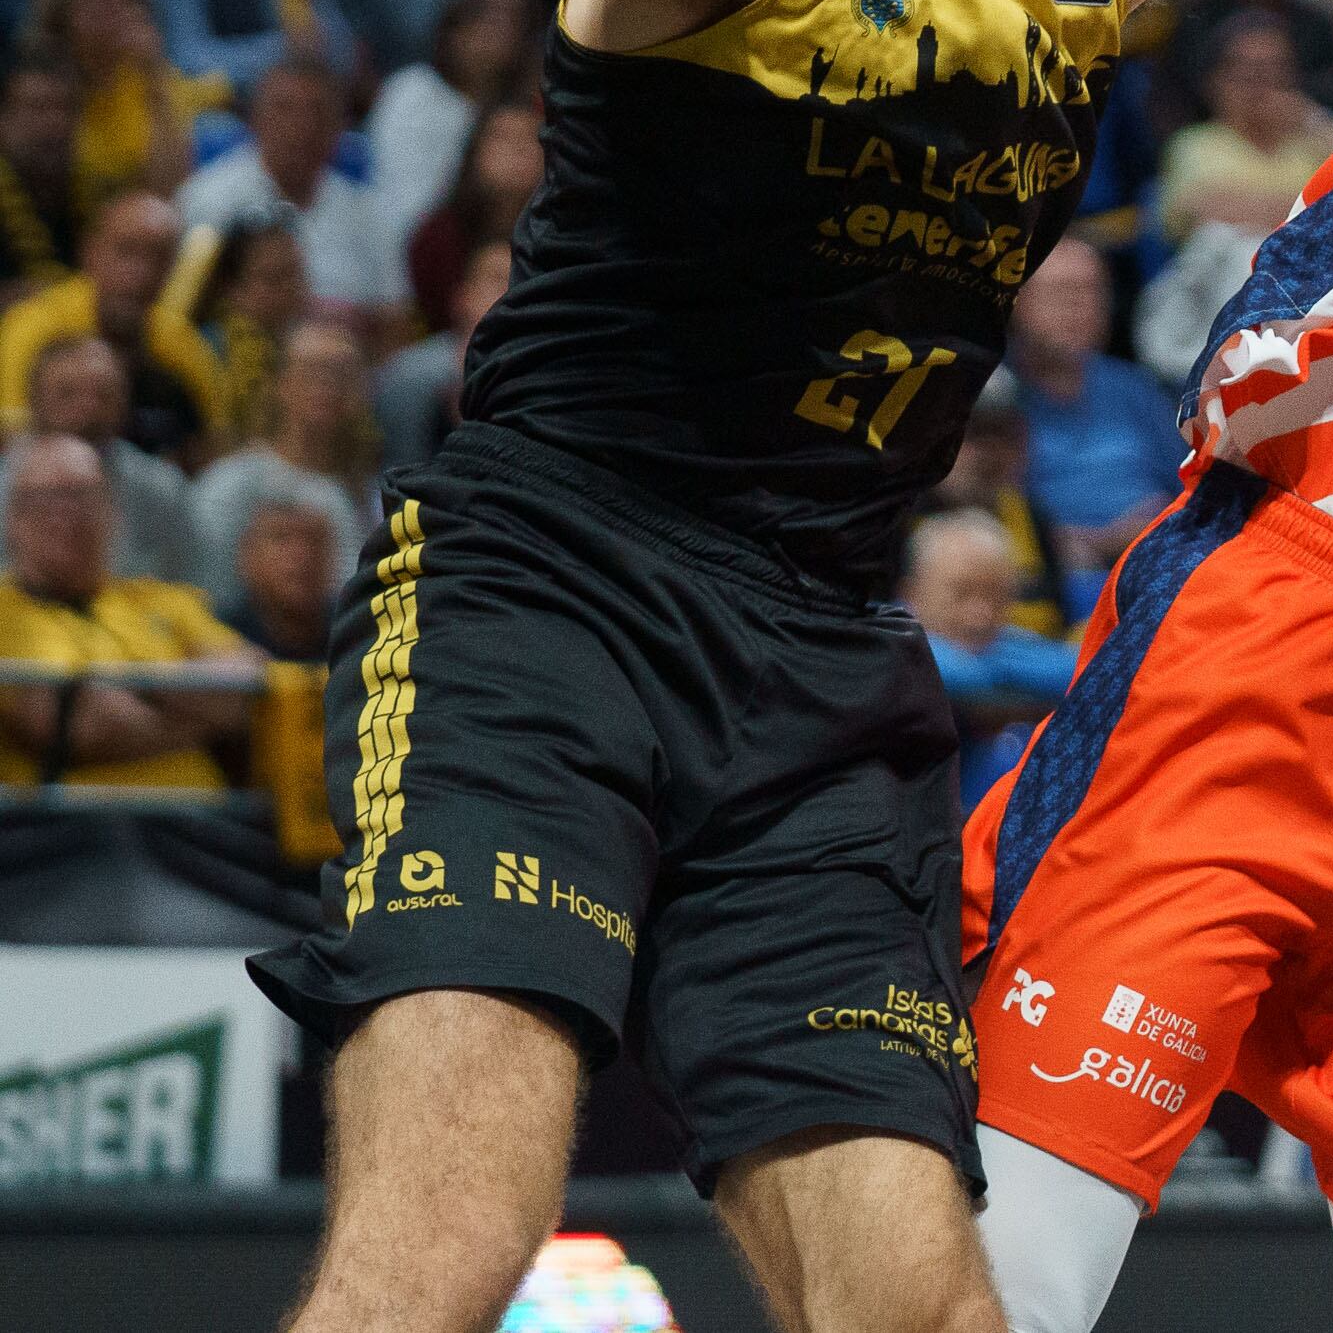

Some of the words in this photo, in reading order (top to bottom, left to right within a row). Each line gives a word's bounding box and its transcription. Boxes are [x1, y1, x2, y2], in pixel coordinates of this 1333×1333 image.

[805, 116, 901, 185] LA
[793, 328, 958, 452] 21
[386, 892, 464, 913] austral
[886, 983, 953, 1025] Islas
[1144, 1001, 1198, 1039] XUNTA
[1136, 1020, 1160, 1042] DE
[1162, 1032, 1209, 1064] GALICIA
[1030, 1046, 1187, 1115] galicia
